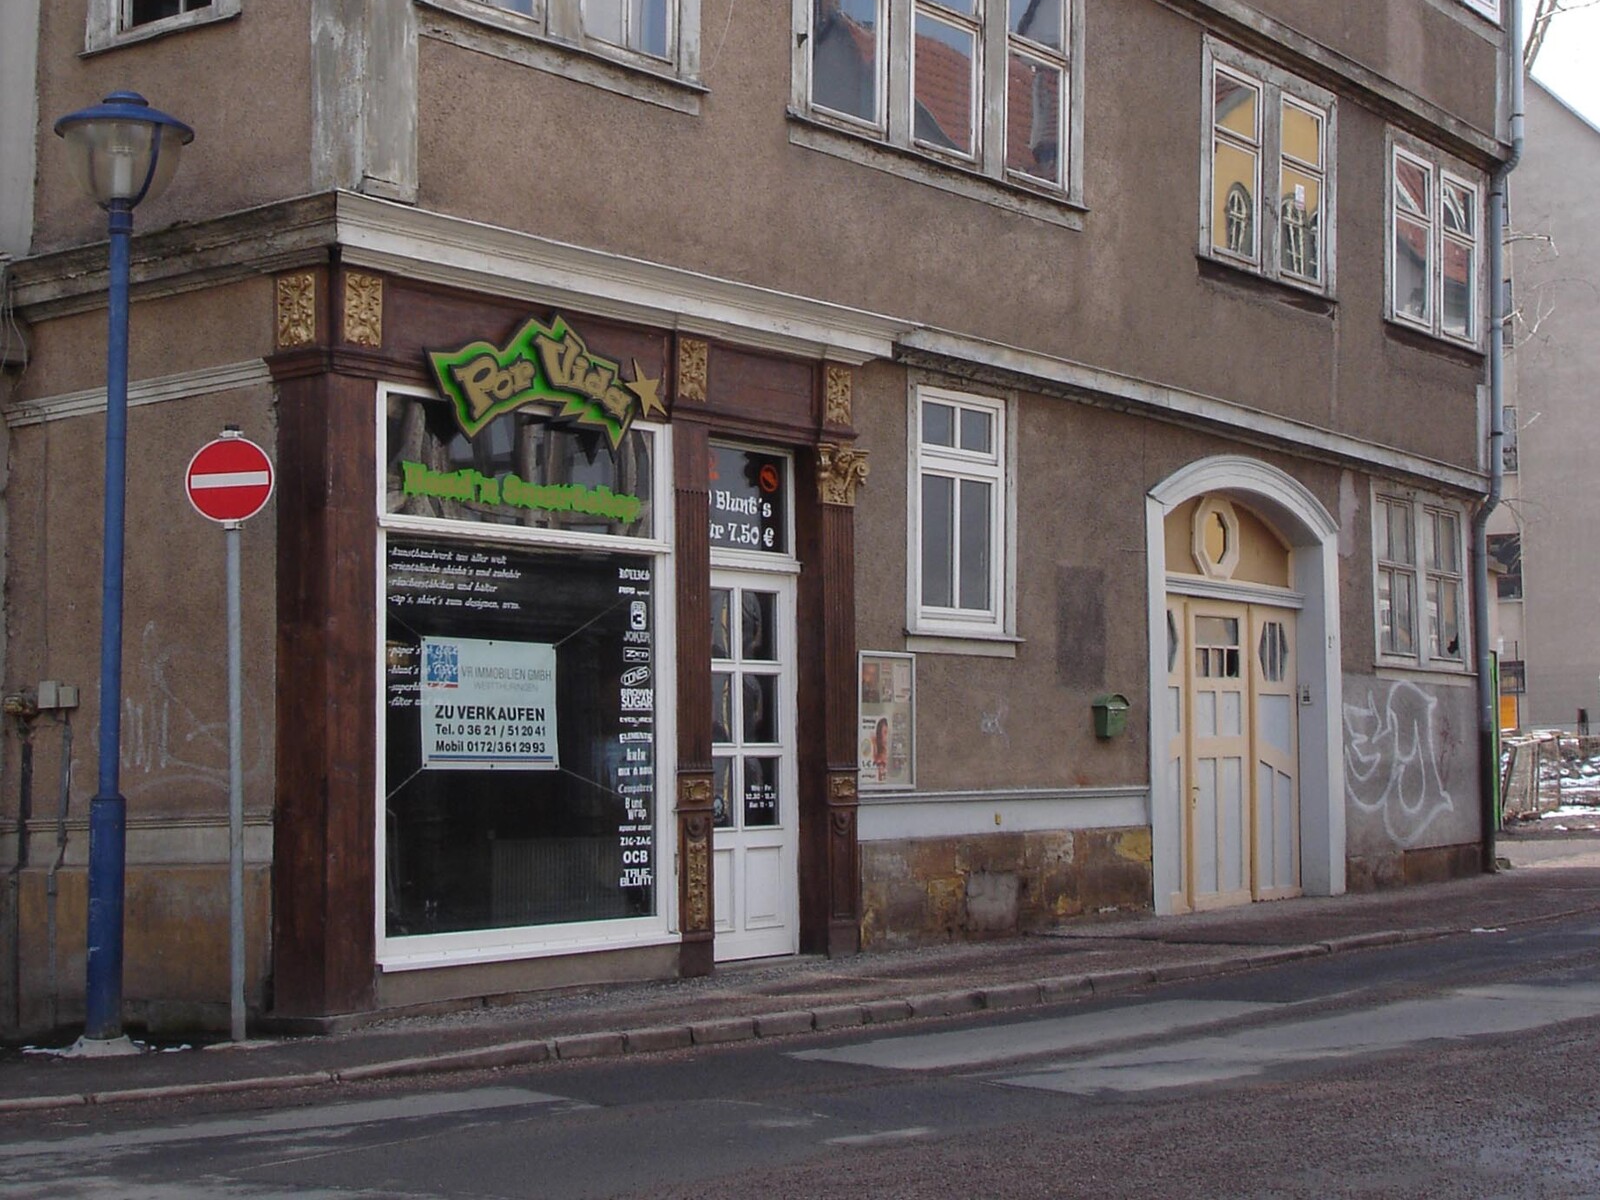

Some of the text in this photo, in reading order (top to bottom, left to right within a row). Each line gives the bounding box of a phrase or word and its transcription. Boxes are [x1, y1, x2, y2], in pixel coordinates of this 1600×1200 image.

[452, 331, 634, 426] Por Vida
[763, 527, 774, 547] €
[474, 666, 526, 681] IMMOBILIEN
[621, 689, 653, 697] BROWN
[621, 696, 653, 708] SUGAR
[435, 704, 545, 721] ZU VERKAUFEN
[435, 723, 455, 735] Tel.
[435, 740, 464, 752] Mobil
[620, 836, 652, 846] ZIG-ZAG
[623, 850, 648, 864] OCB
